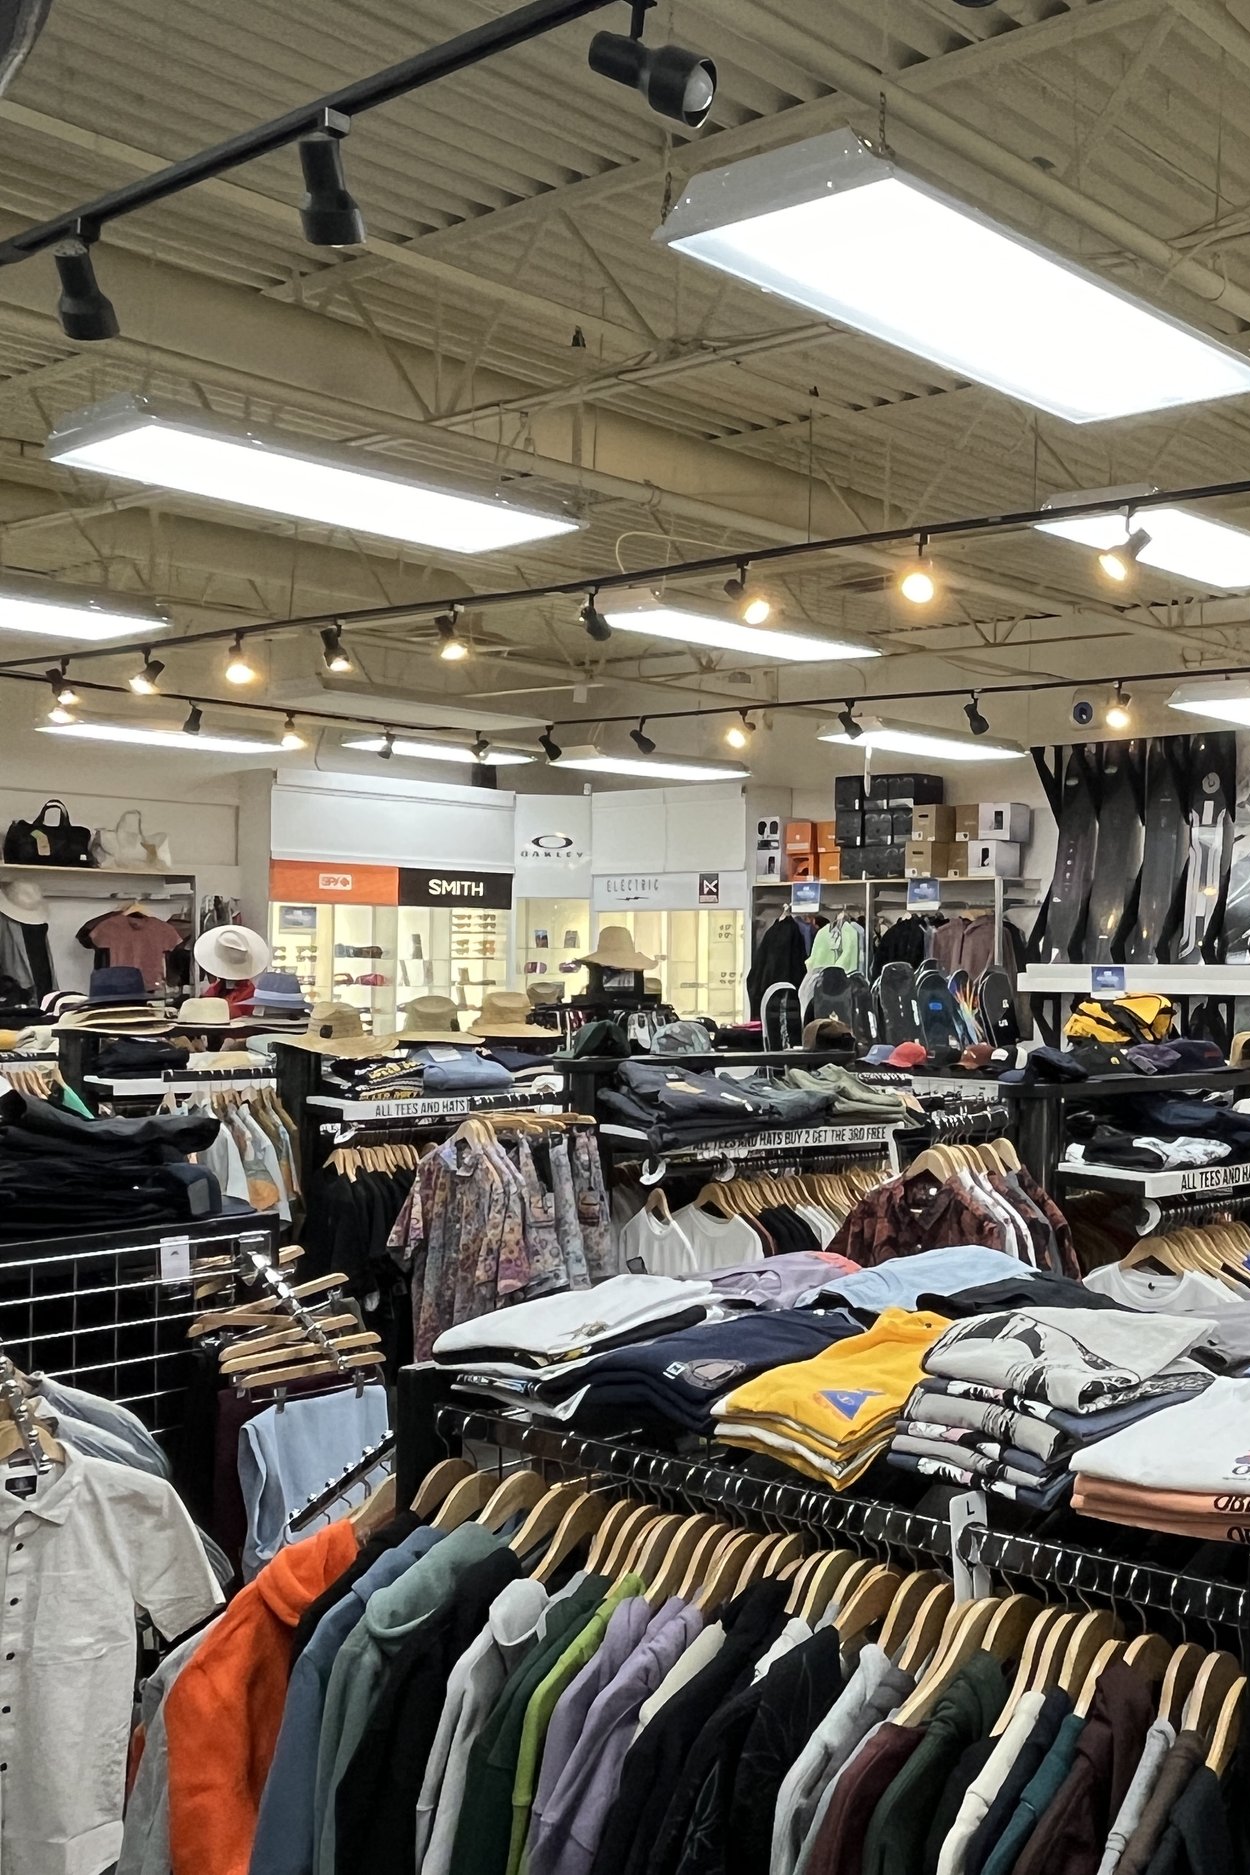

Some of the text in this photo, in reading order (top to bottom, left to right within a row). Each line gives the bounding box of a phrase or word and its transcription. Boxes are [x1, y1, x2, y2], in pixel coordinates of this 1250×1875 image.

[520, 850, 584, 858] OAKLEY
[428, 878, 484, 897] SMITH
[606, 879, 660, 893] ELECTRIC
[375, 1100, 466, 1117] ALL TEES AND HATS
[760, 1131, 783, 1147] HATS
[785, 1131, 803, 1146] BUY
[804, 1131, 811, 1144] 2
[812, 1129, 829, 1144] GET
[831, 1128, 846, 1143] THE
[866, 1126, 886, 1140] FREE
[1181, 1173, 1197, 1192] ALL
[1199, 1170, 1221, 1189] TEES
[1222, 1167, 1241, 1186] AND
[966, 1500, 975, 1516] L
